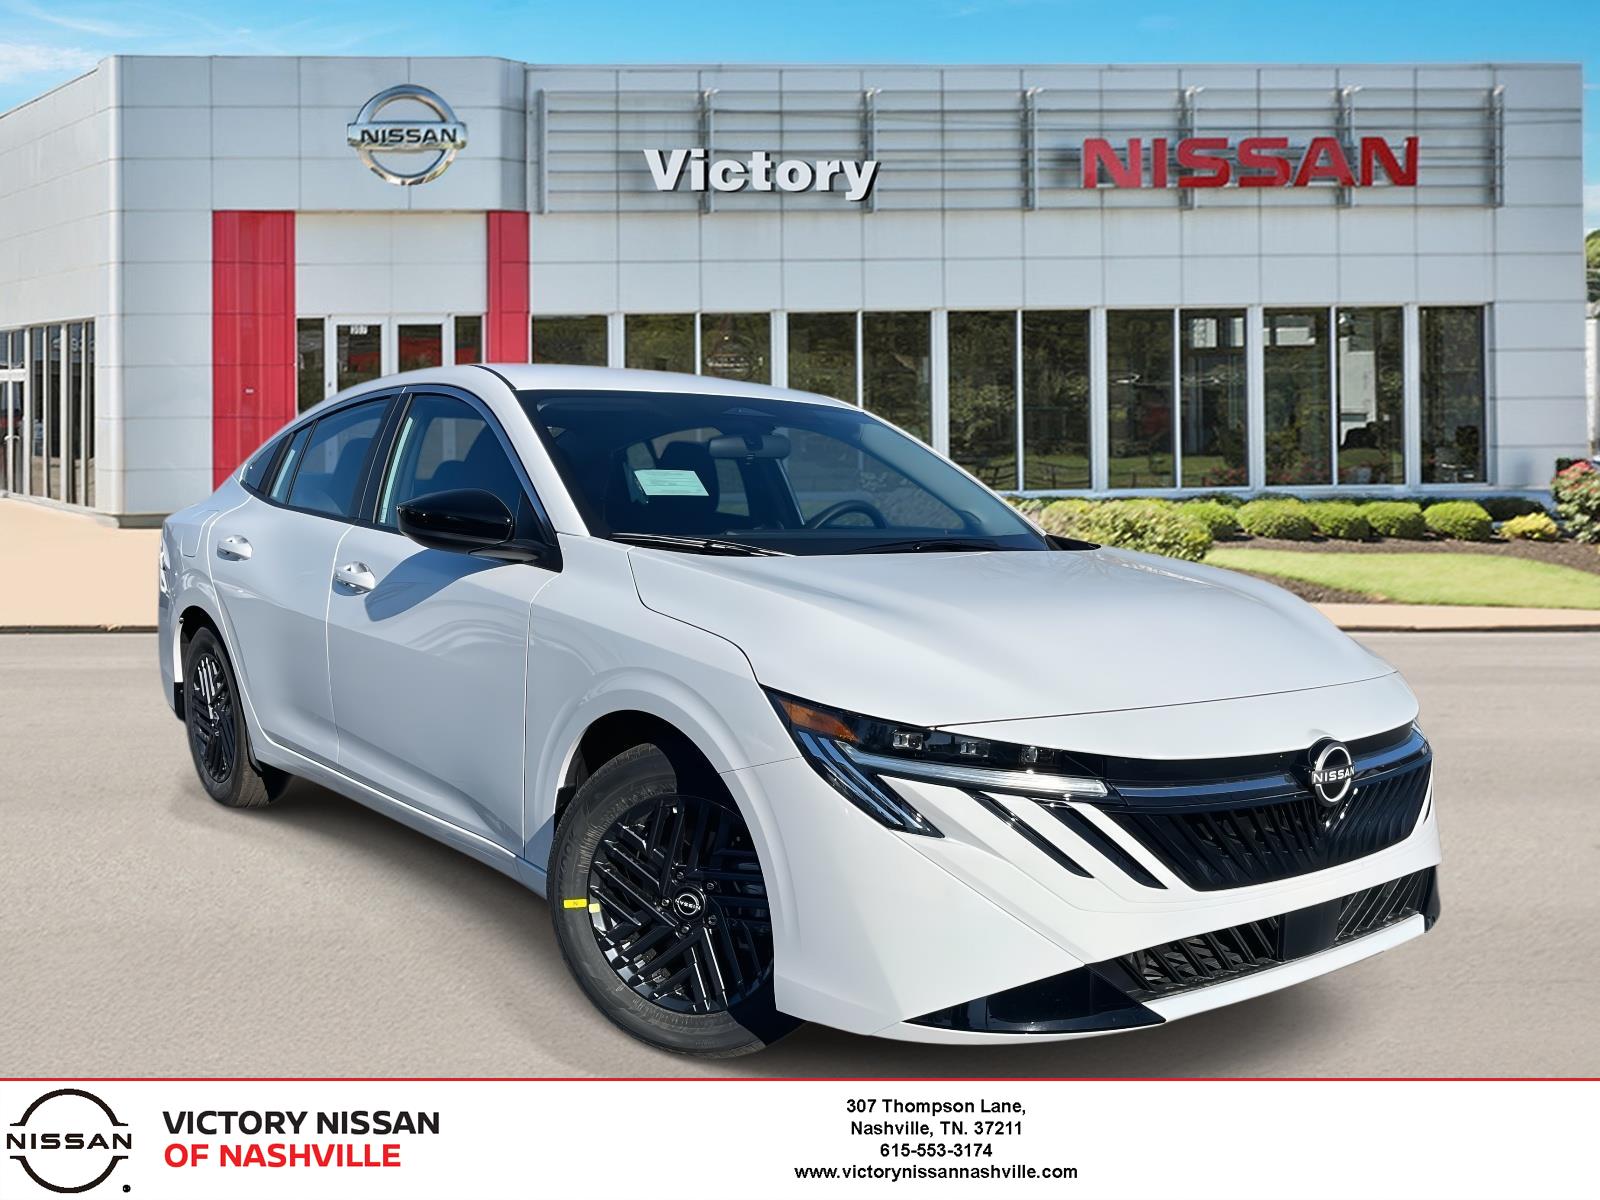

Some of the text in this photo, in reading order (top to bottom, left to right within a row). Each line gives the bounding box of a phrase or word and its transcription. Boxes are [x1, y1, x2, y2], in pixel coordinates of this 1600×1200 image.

[360, 127, 458, 144] NISSAN
[644, 149, 880, 202] Victory
[1082, 136, 1420, 189] NISSAN
[1313, 765, 1355, 784] NISSAN
